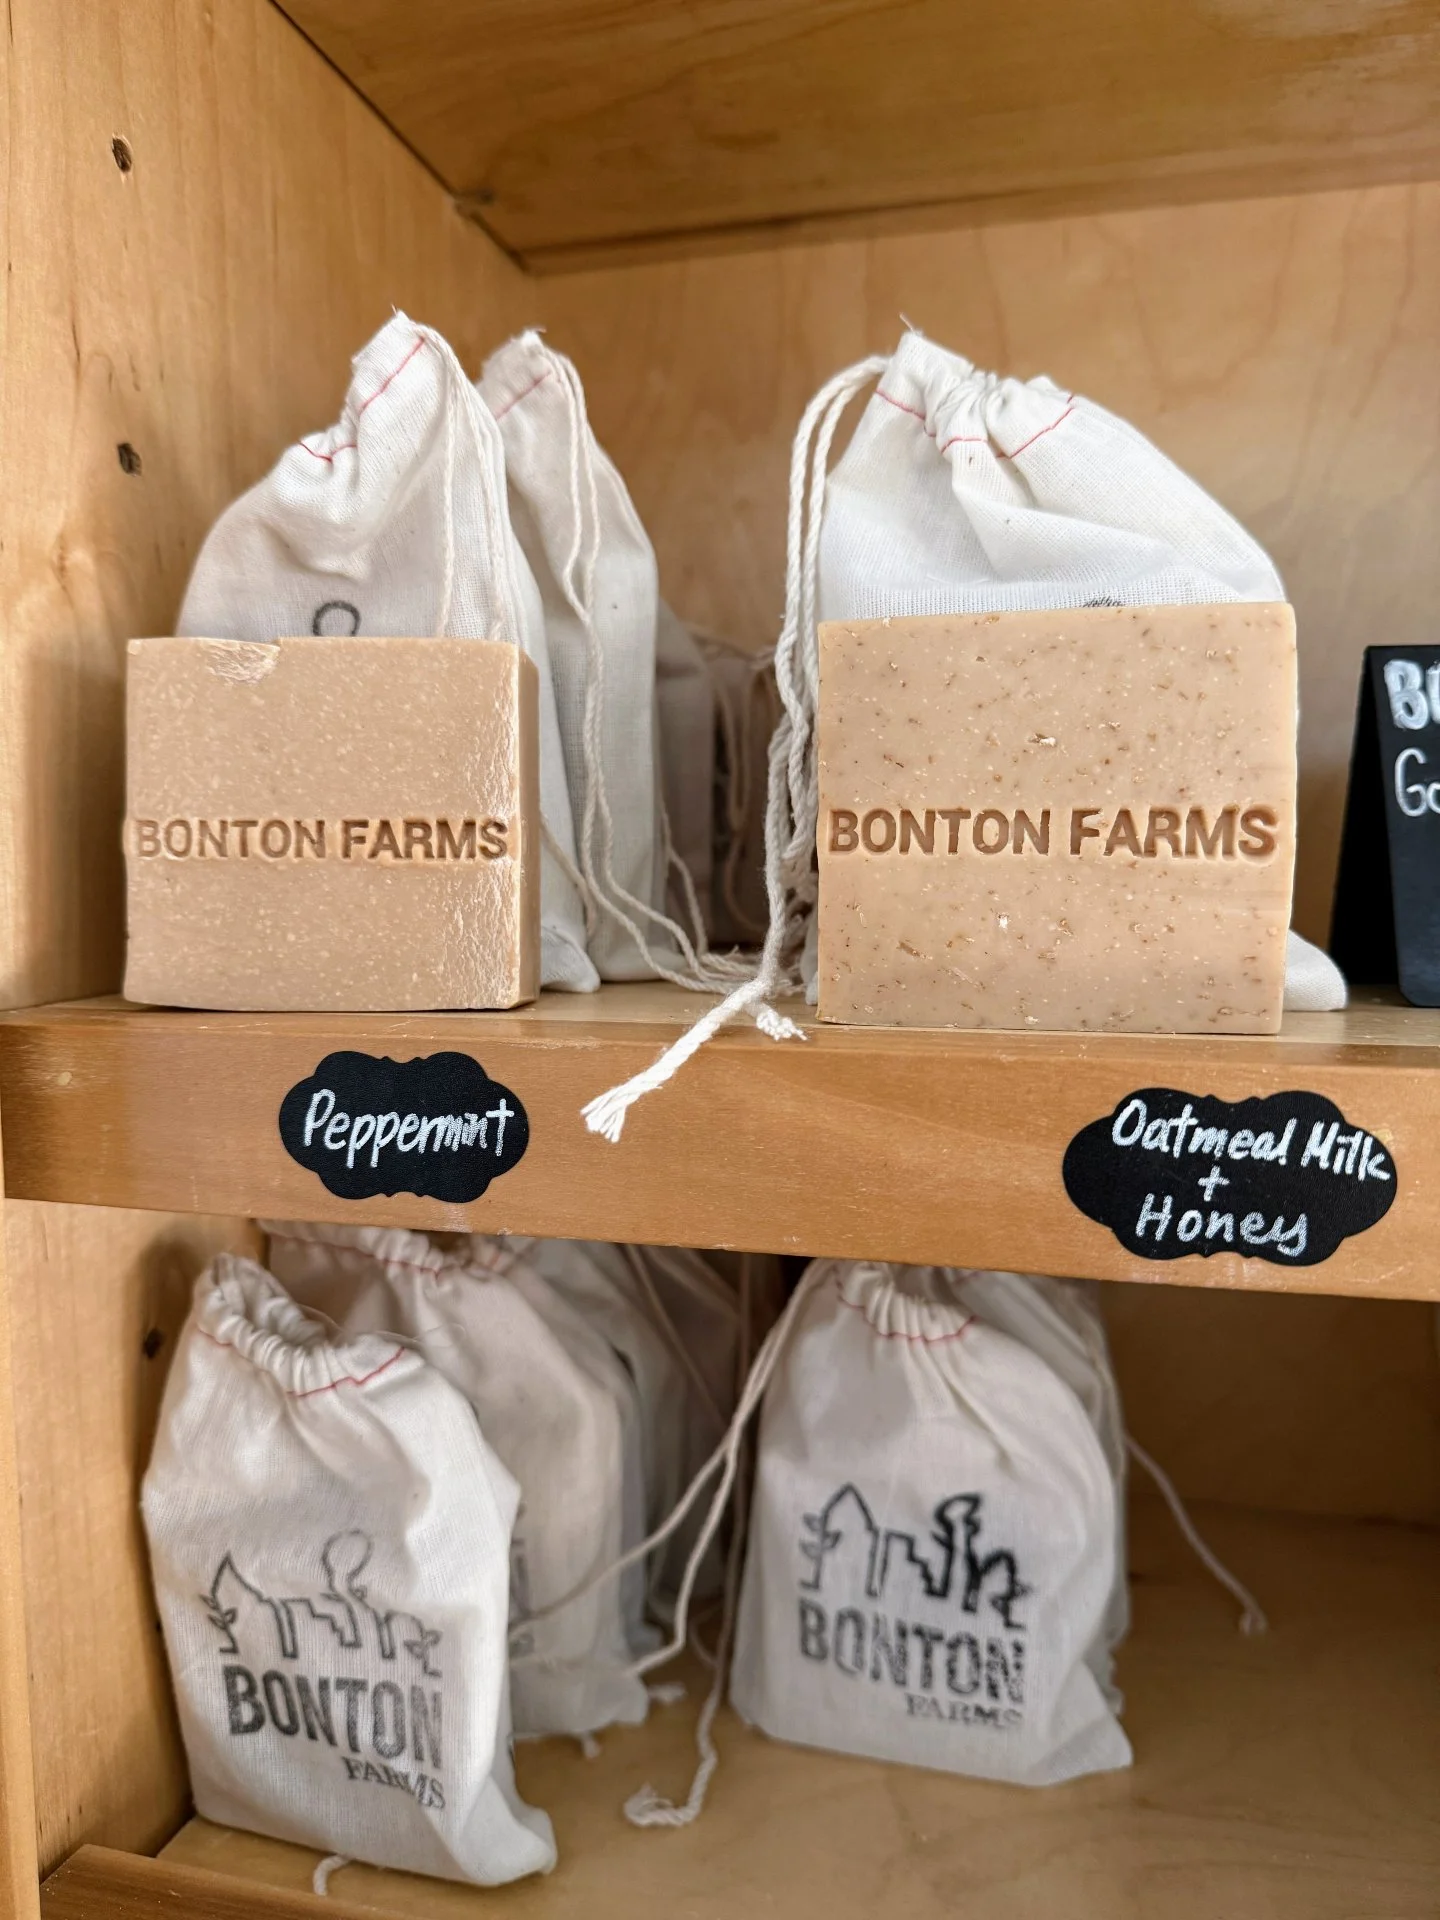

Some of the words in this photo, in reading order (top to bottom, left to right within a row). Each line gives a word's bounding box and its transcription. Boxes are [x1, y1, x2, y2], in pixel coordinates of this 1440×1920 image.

[136, 819, 326, 858] BONTON
[342, 819, 508, 860] FARMS
[828, 808, 1051, 856] BONTON
[1069, 807, 1278, 861] FARMS
[303, 1088, 515, 1169] Peppermint
[1111, 1099, 1298, 1166] Oatmeal
[1300, 1118, 1391, 1182] Milk
[1135, 1193, 1309, 1257] Honey
[799, 1597, 1026, 1703] BONTON
[222, 1664, 442, 1769] BONTON
[903, 1693, 1024, 1729] FARMS
[341, 1755, 447, 1810] FARMS
